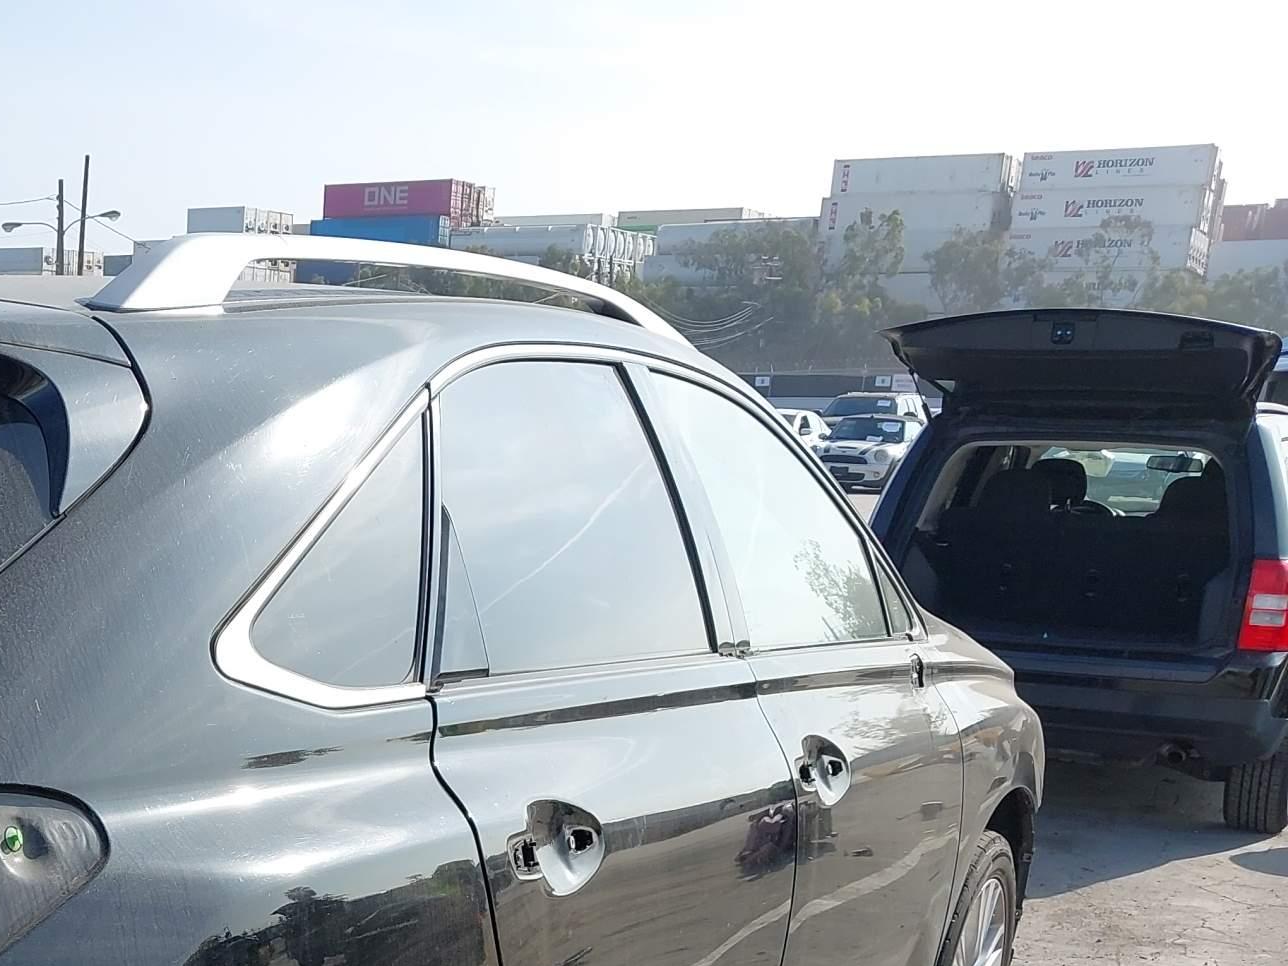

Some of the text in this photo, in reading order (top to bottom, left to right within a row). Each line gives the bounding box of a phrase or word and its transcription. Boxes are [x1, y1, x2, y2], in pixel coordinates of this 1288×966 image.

[1096, 157, 1155, 168] HORIZON
[364, 186, 409, 205] ONE
[1086, 198, 1144, 208] HORIZON
